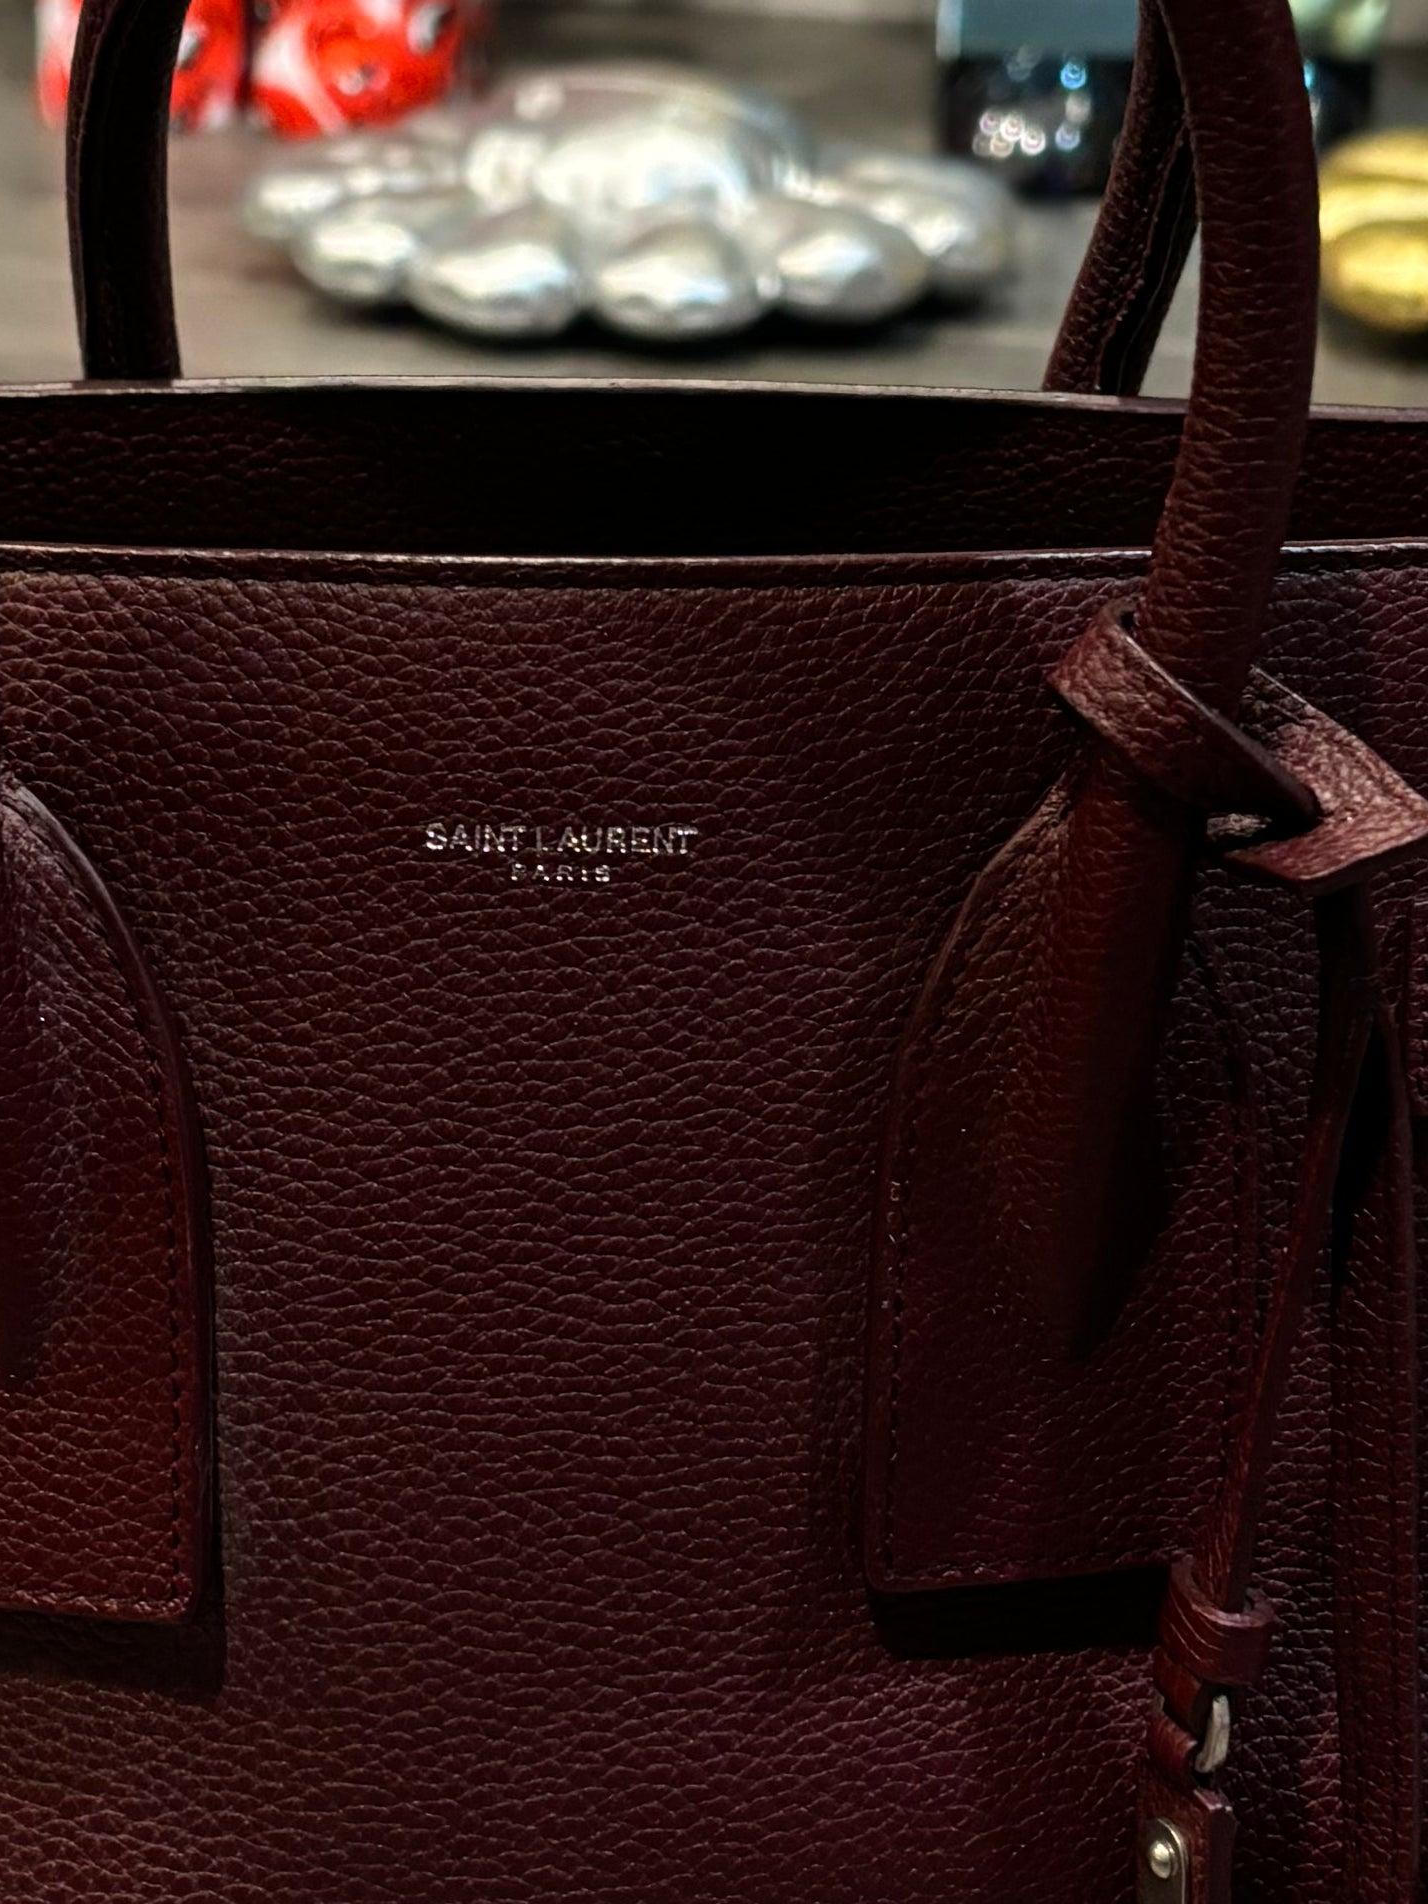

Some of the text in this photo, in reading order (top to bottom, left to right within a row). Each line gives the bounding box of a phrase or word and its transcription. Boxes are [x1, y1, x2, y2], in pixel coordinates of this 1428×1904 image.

[424, 822, 699, 855] SAINT LAURENT
[509, 861, 612, 883] PARIS
